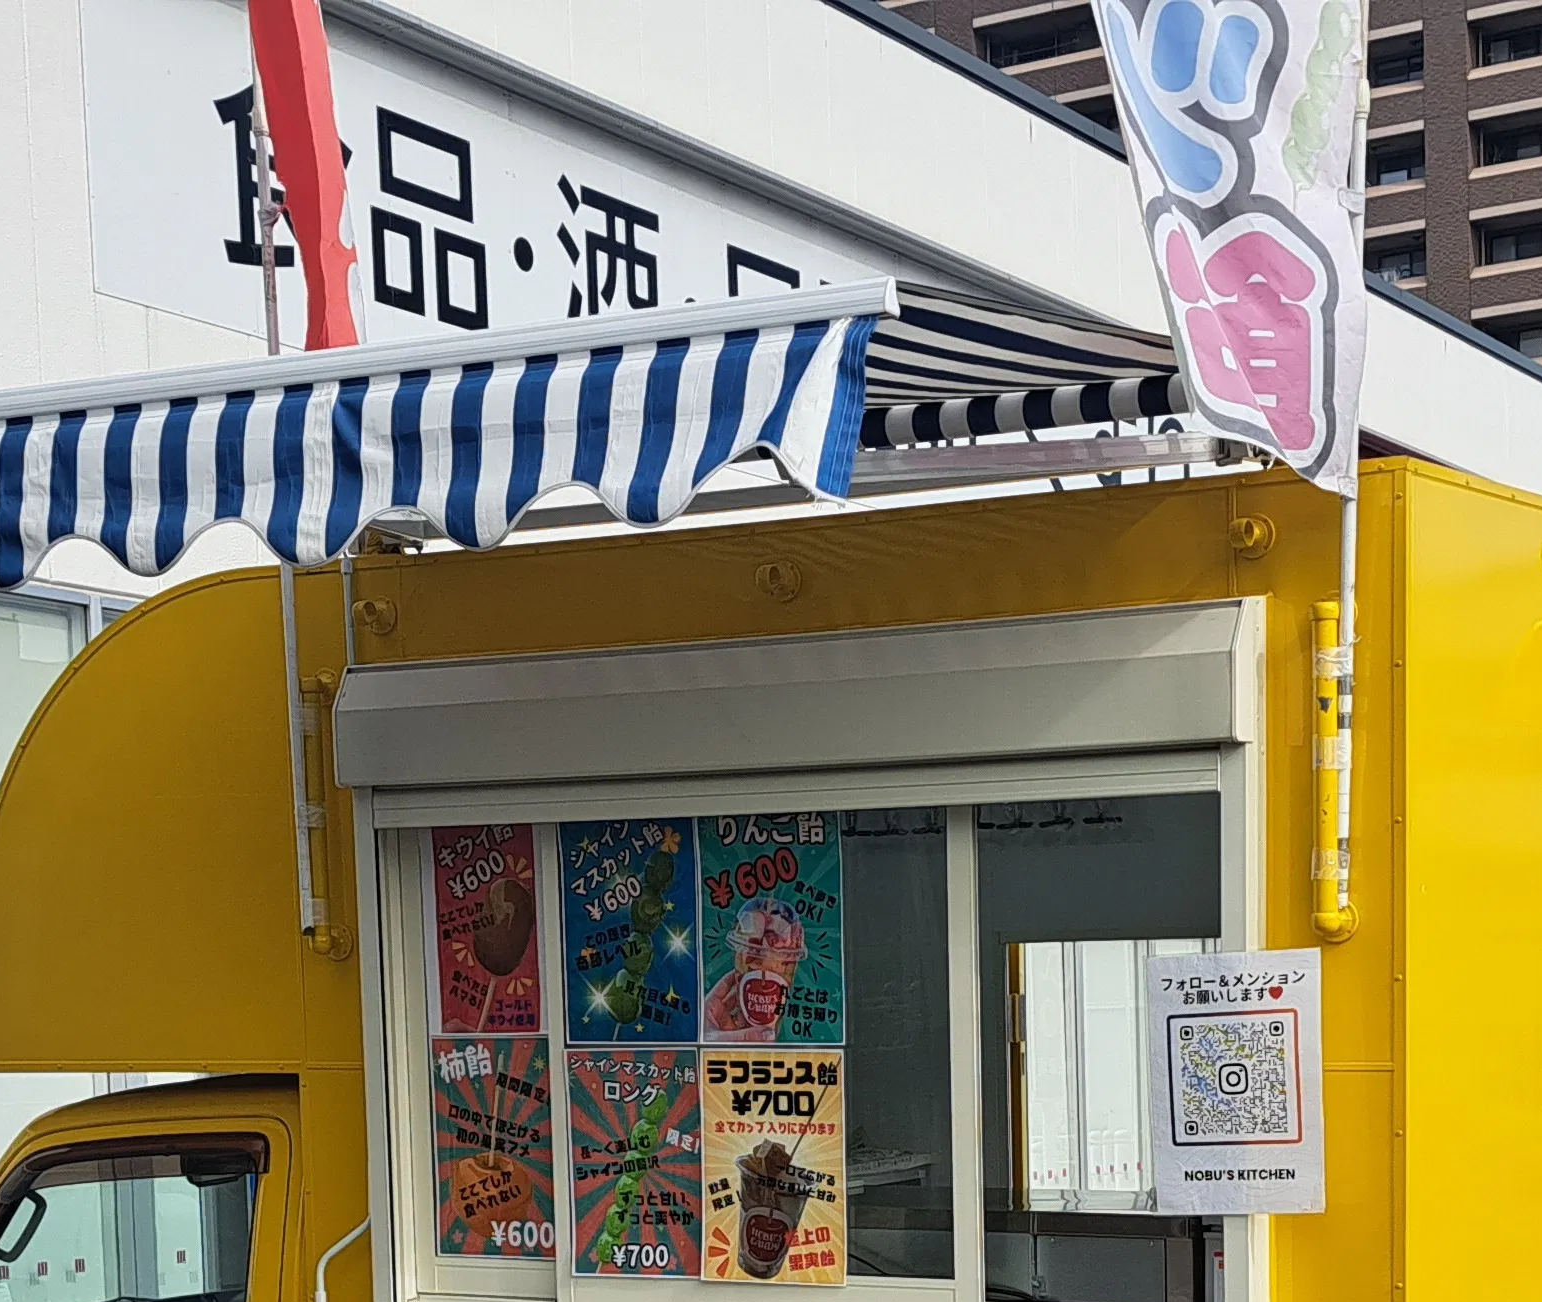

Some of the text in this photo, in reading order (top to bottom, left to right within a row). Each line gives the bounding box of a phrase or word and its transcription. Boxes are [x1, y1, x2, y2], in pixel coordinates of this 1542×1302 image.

[569, 820, 629, 868] シャイン
[571, 822, 664, 895] マスカット飴
[447, 850, 505, 899] ¥600
[705, 847, 799, 909] ¥600
[584, 876, 641, 921] ¥600
[795, 900, 824, 923] OK!
[1161, 970, 1306, 992] フォロー&メンション
[1183, 987, 1267, 1005] お願いします
[791, 1022, 813, 1038] OK
[439, 1043, 492, 1083] 柿飴
[706, 1060, 838, 1086] ラフランス飴
[603, 1080, 661, 1106] ロング
[732, 1089, 816, 1116] ¥700
[1184, 1168, 1296, 1182] NOBU'S KITCHEN
[491, 1219, 554, 1248] ¥600
[611, 1244, 670, 1268] ¥700
